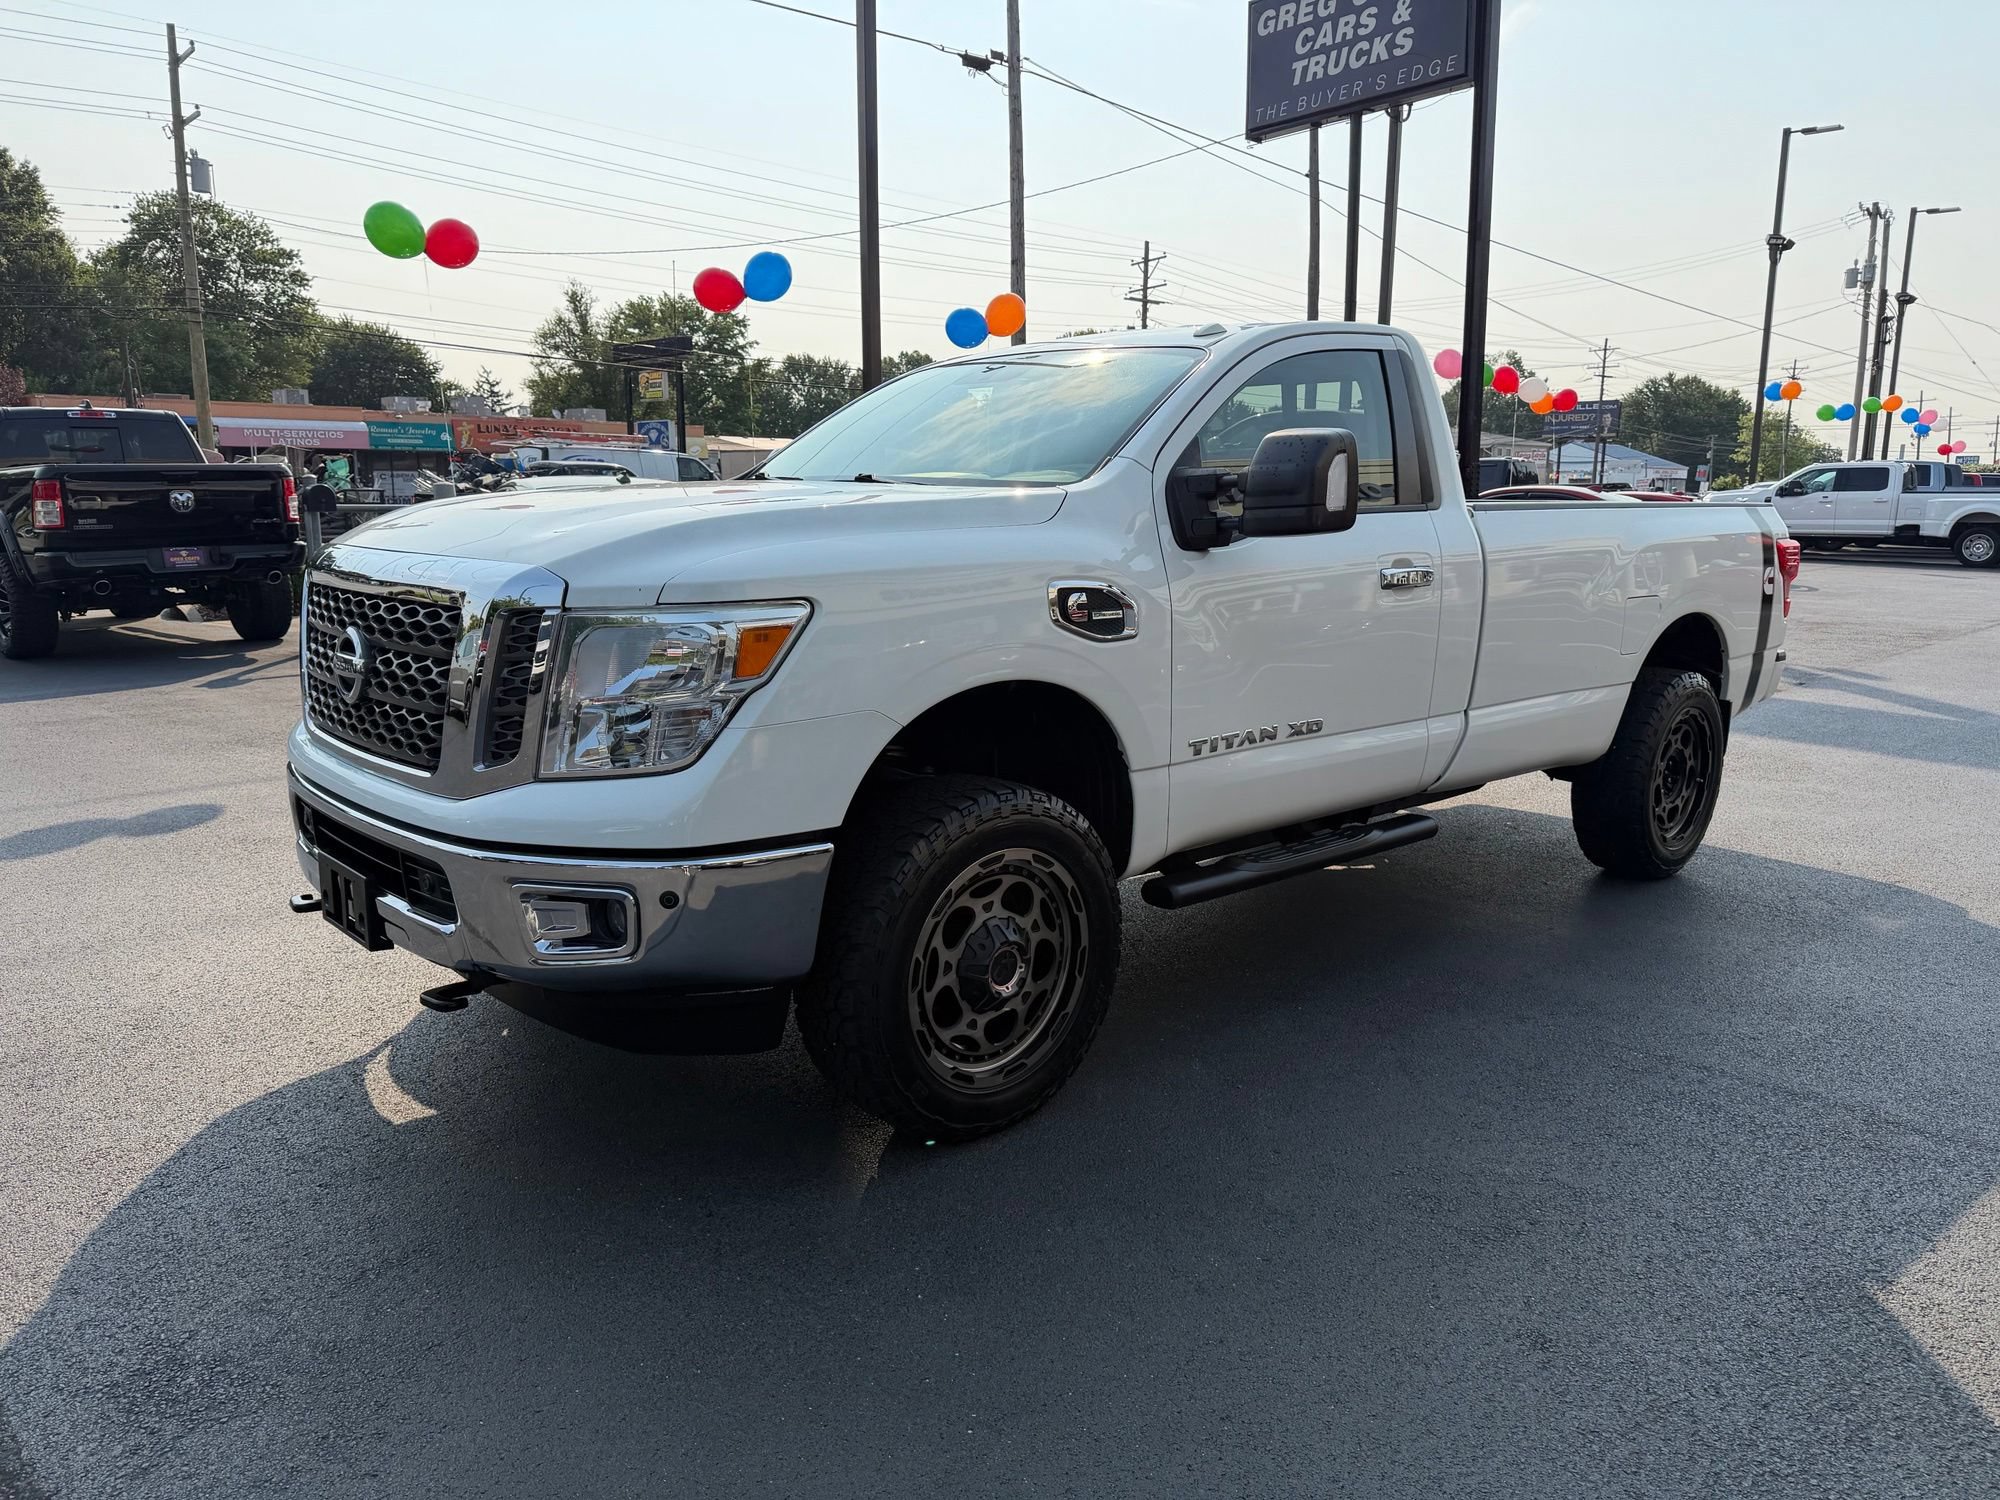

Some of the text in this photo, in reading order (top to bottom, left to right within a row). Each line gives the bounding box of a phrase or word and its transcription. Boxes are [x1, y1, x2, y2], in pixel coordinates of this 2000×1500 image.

[1257, 0, 1336, 36] GREG
[1295, 0, 1412, 55] CARS &
[1292, 27, 1415, 86] TRUCKS
[1256, 54, 1458, 123] THE BUYER'S EDGE
[477, 424, 518, 434] LUNA'S
[1545, 413, 1596, 422] INJURED?
[243, 428, 344, 439] MULTI-SERVICIOS
[271, 438, 320, 446] LATINOS
[405, 426, 436, 435] Jewelry
[1188, 718, 1323, 756] TITAN XD
